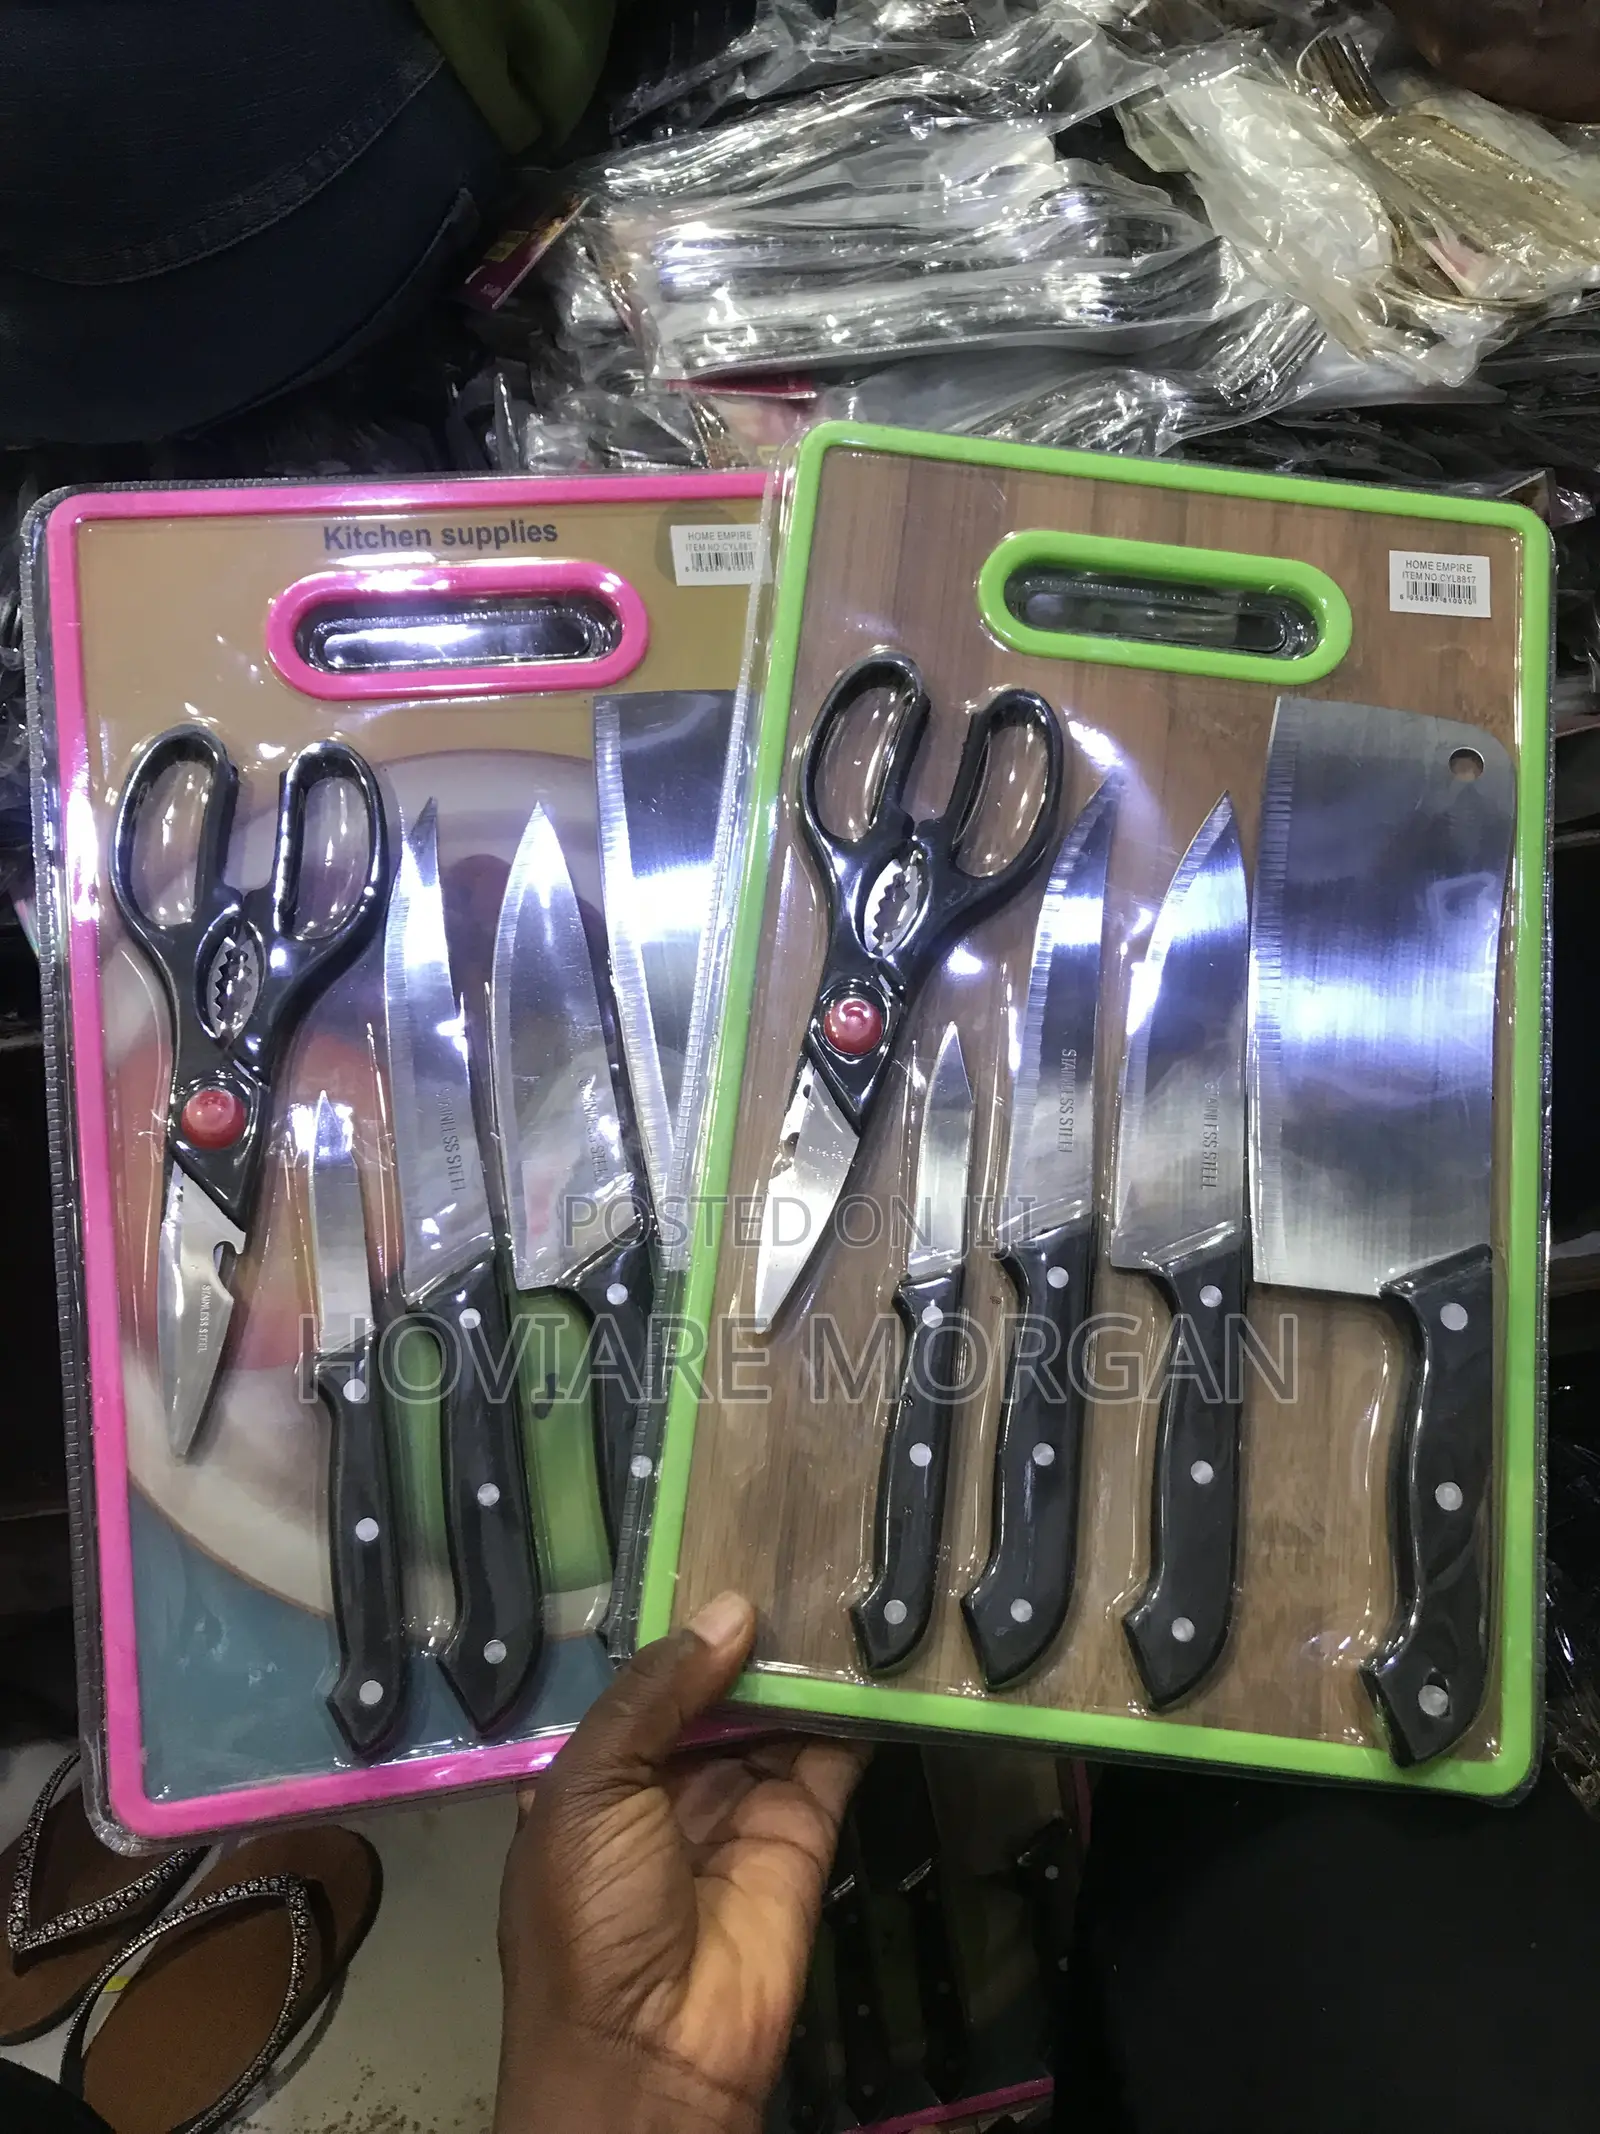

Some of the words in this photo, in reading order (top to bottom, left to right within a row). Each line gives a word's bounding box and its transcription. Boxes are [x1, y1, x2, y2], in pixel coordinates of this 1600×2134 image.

[323, 524, 432, 550] Kitchen
[441, 518, 559, 550] supplies
[685, 543, 706, 552] ITEM
[688, 531, 716, 540] HOME
[717, 531, 753, 540] EMPIRE
[1402, 571, 1423, 580] ITEM
[1440, 574, 1476, 584] CYL8817
[1405, 560, 1434, 571] HOME
[1436, 562, 1473, 573] EMPIRE
[1060, 1048, 1077, 1115] STAINLESS
[436, 1087, 460, 1153] STAINLESS
[1202, 1082, 1220, 1149] STAINLESS
[1058, 1117, 1074, 1153] STEEL
[446, 1154, 466, 1195] STEEL
[1201, 1152, 1218, 1190] STEEL
[200, 1284, 212, 1327] STAINLESS
[197, 1328, 209, 1354] STEEL
